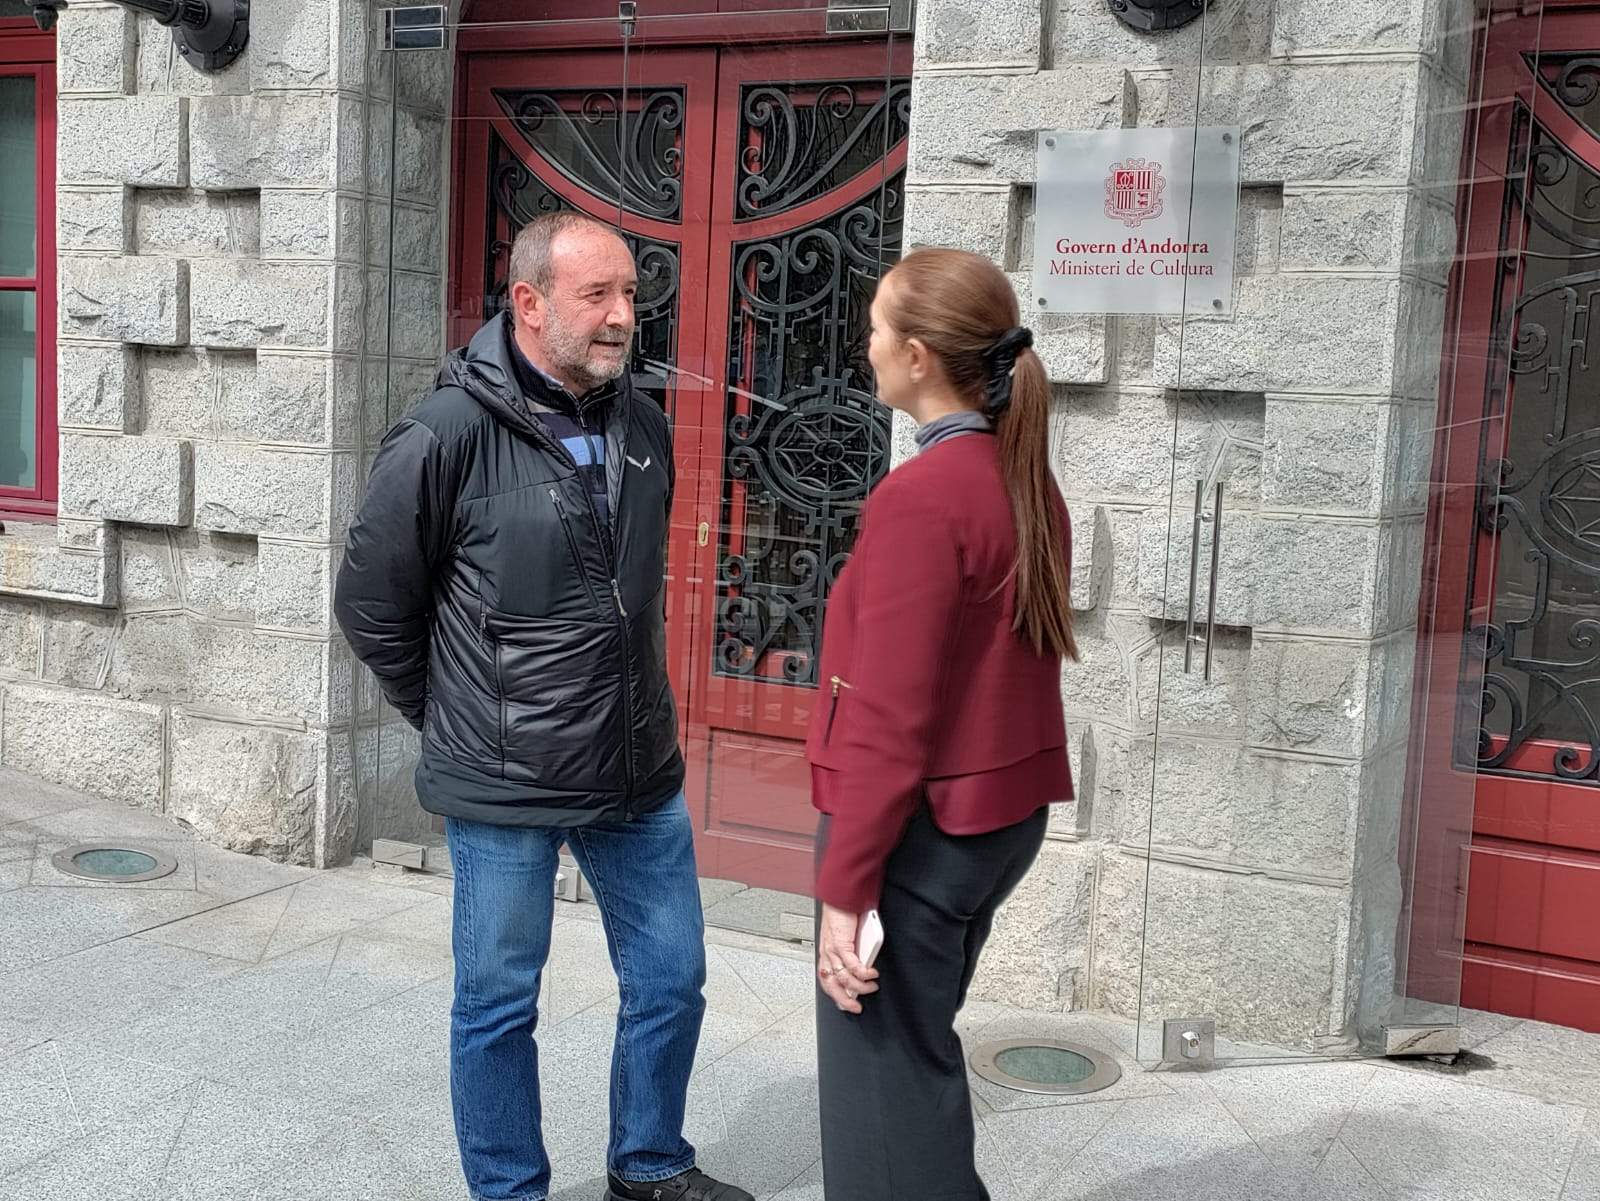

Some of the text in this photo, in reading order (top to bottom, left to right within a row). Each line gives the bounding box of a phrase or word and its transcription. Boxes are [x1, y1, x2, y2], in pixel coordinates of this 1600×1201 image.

[1056, 238, 1208, 254] Govern d'Andorra
[1050, 259, 1213, 276] Ministeri de Cultura
